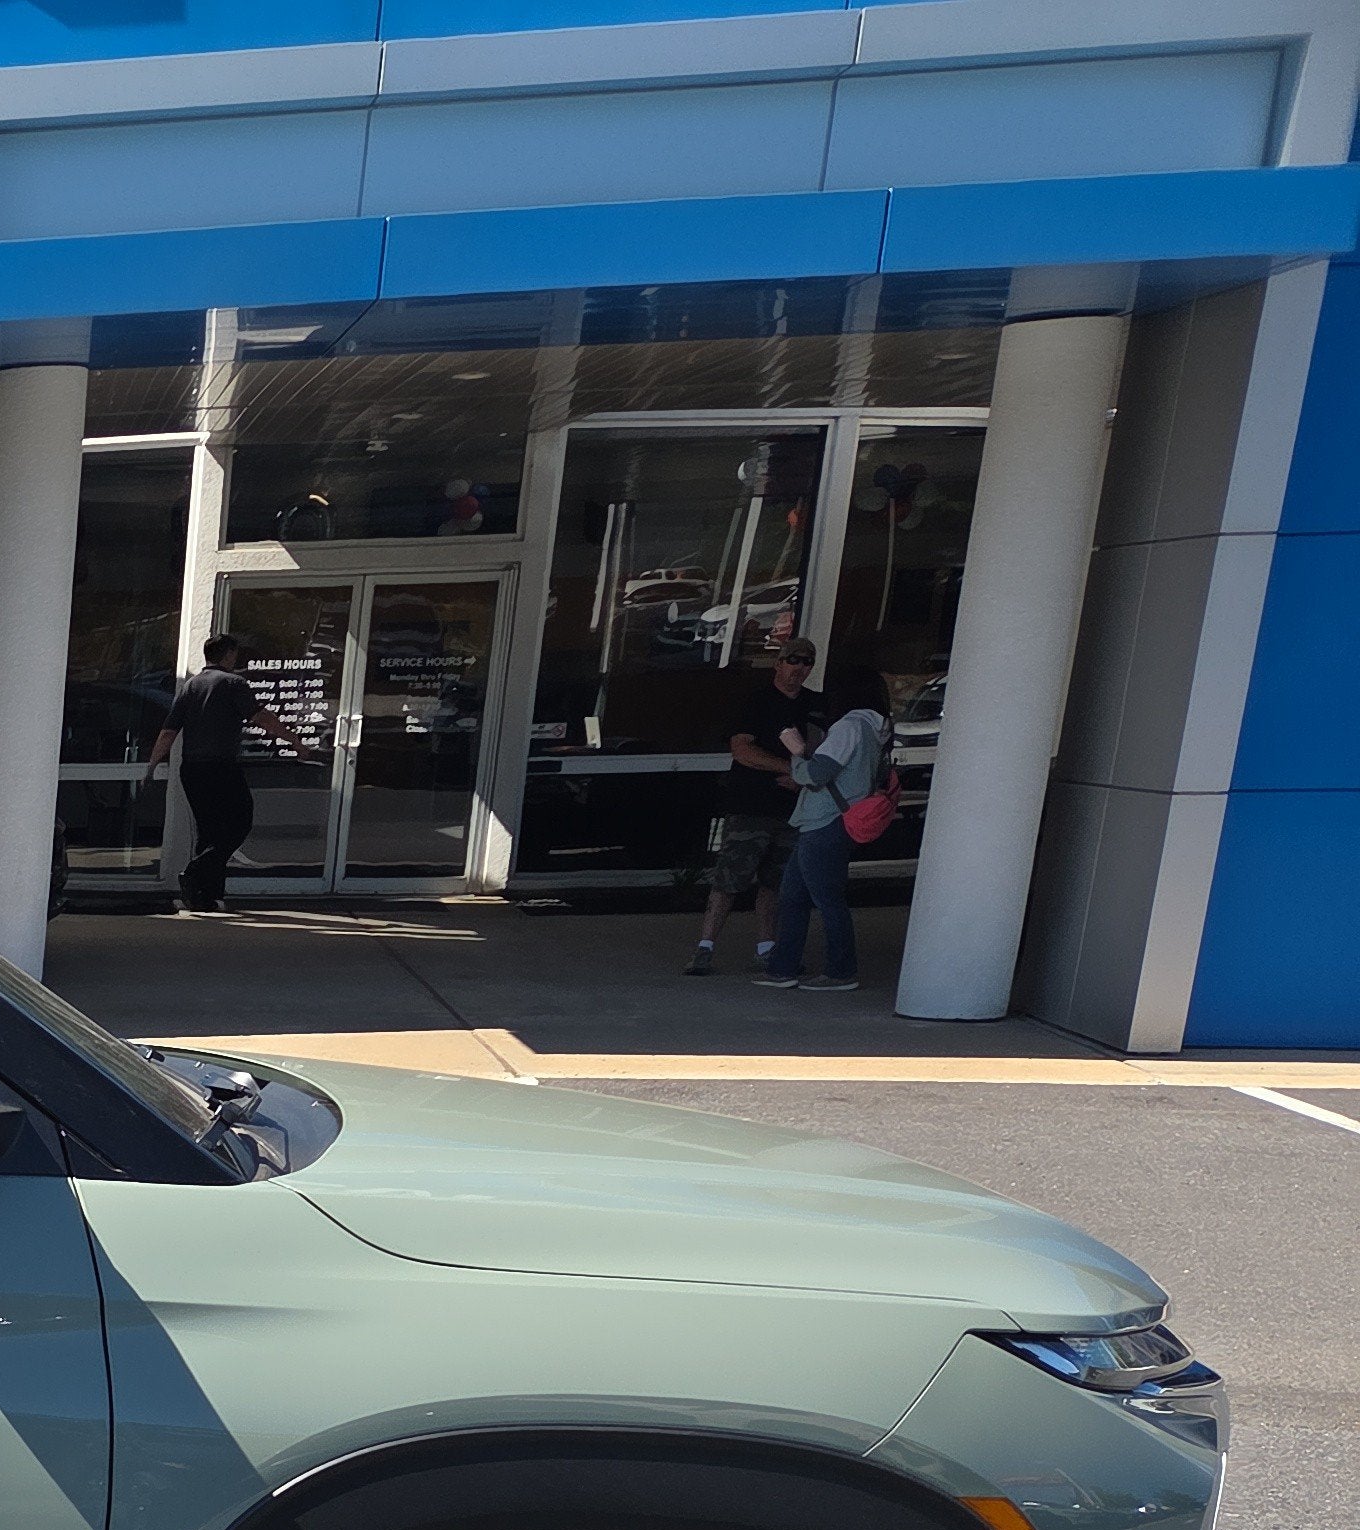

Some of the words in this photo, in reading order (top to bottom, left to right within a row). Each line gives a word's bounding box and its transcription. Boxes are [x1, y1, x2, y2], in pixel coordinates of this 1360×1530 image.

[247, 659, 282, 670] SALES
[283, 658, 322, 670] HOURS
[380, 657, 423, 668] SERVICE
[425, 656, 463, 667] HOURS
